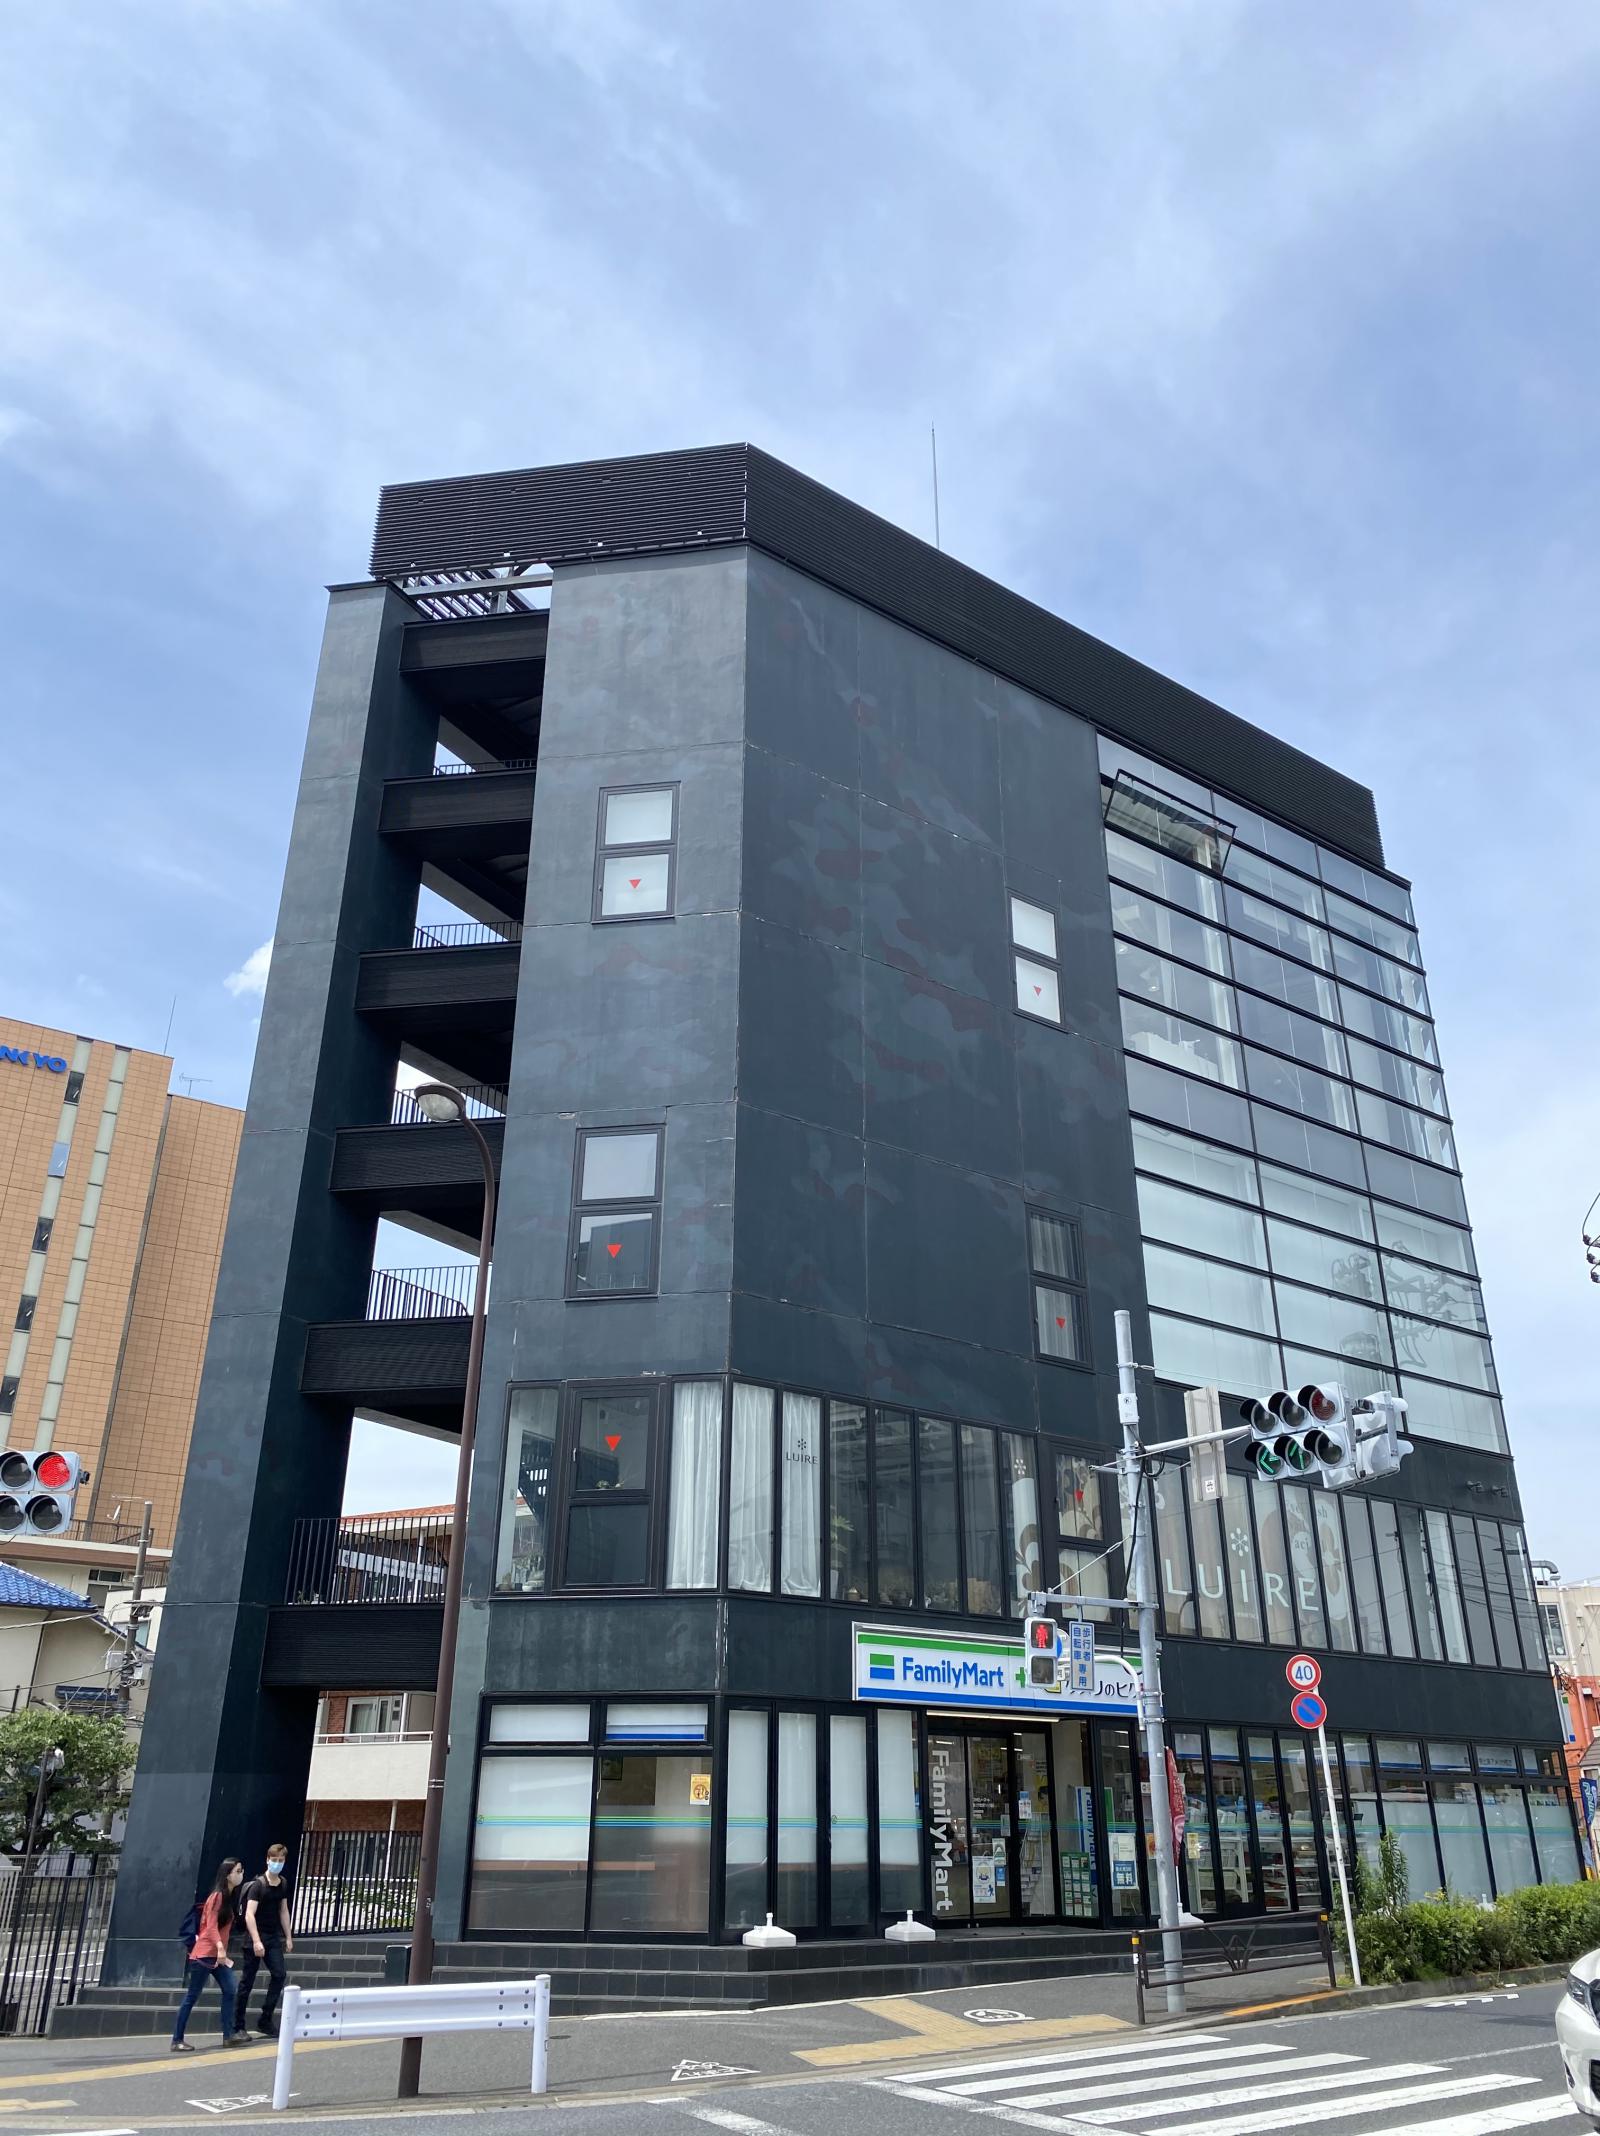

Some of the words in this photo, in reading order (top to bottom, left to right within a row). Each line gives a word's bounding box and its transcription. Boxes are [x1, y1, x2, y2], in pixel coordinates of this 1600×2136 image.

[785, 1451, 818, 1465] LUIRE
[1165, 1559, 1319, 1611] LUIRE
[902, 1656, 1004, 1688] FamilyMart
[1295, 1665, 1313, 1681] 40
[930, 1750, 953, 1911] FamilyMart
